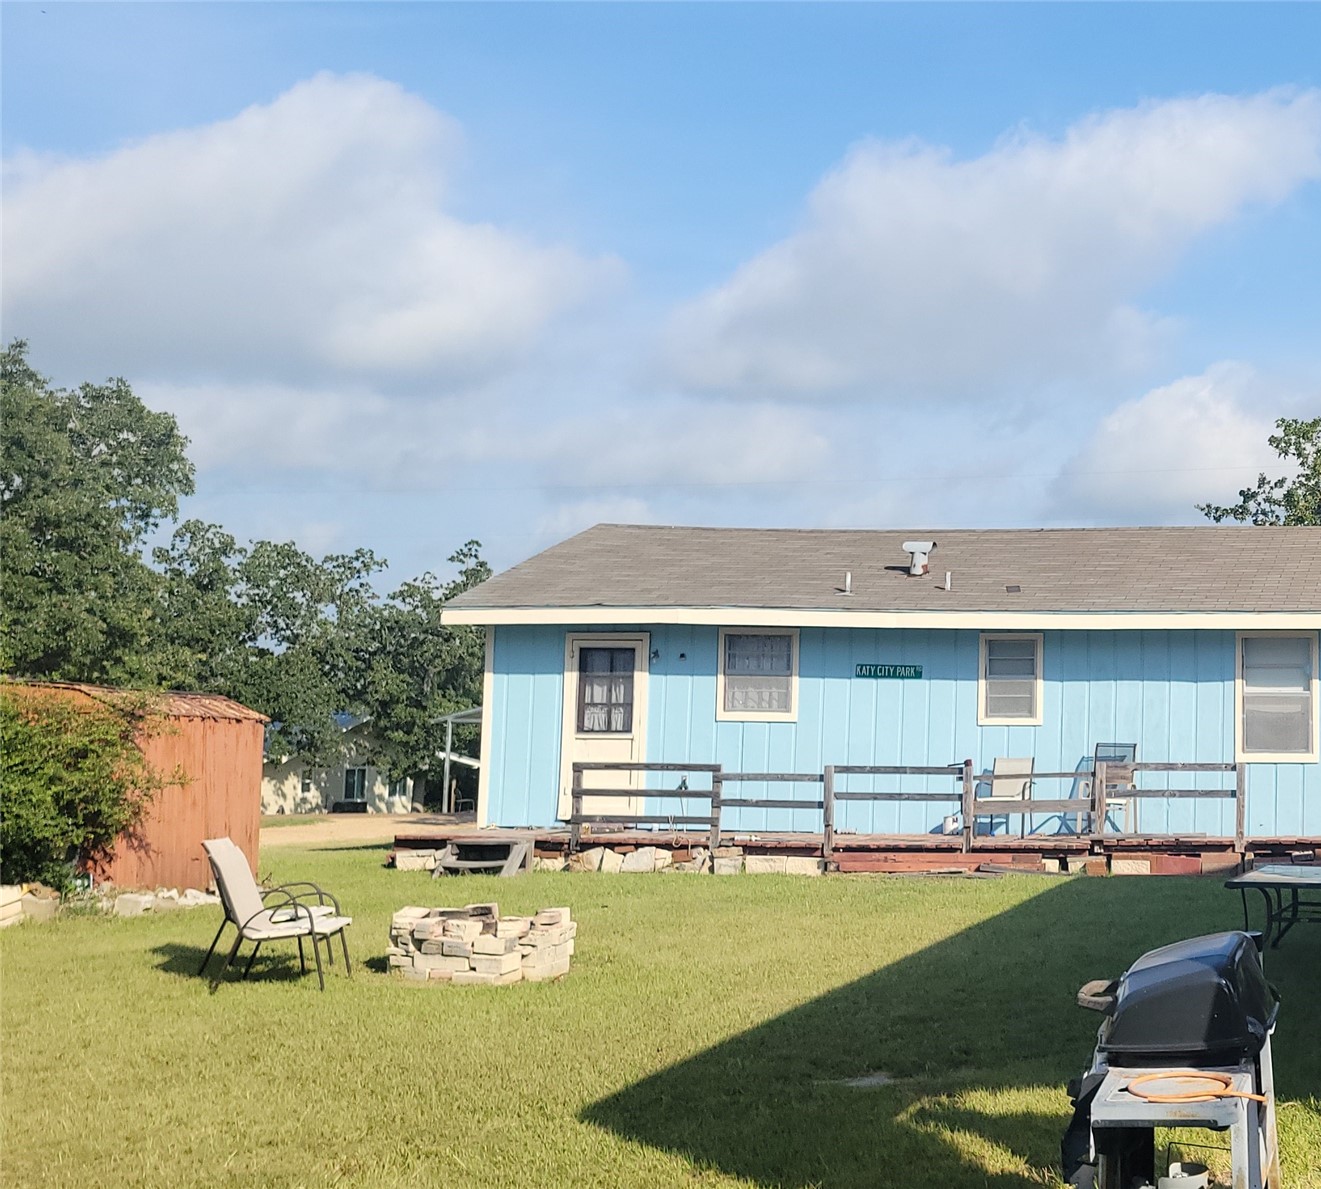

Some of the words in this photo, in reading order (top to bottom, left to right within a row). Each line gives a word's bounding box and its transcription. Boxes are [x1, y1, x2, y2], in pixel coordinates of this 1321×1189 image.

[856, 665, 875, 676] KATY
[877, 665, 894, 677] CITY
[896, 666, 915, 677] PARK
